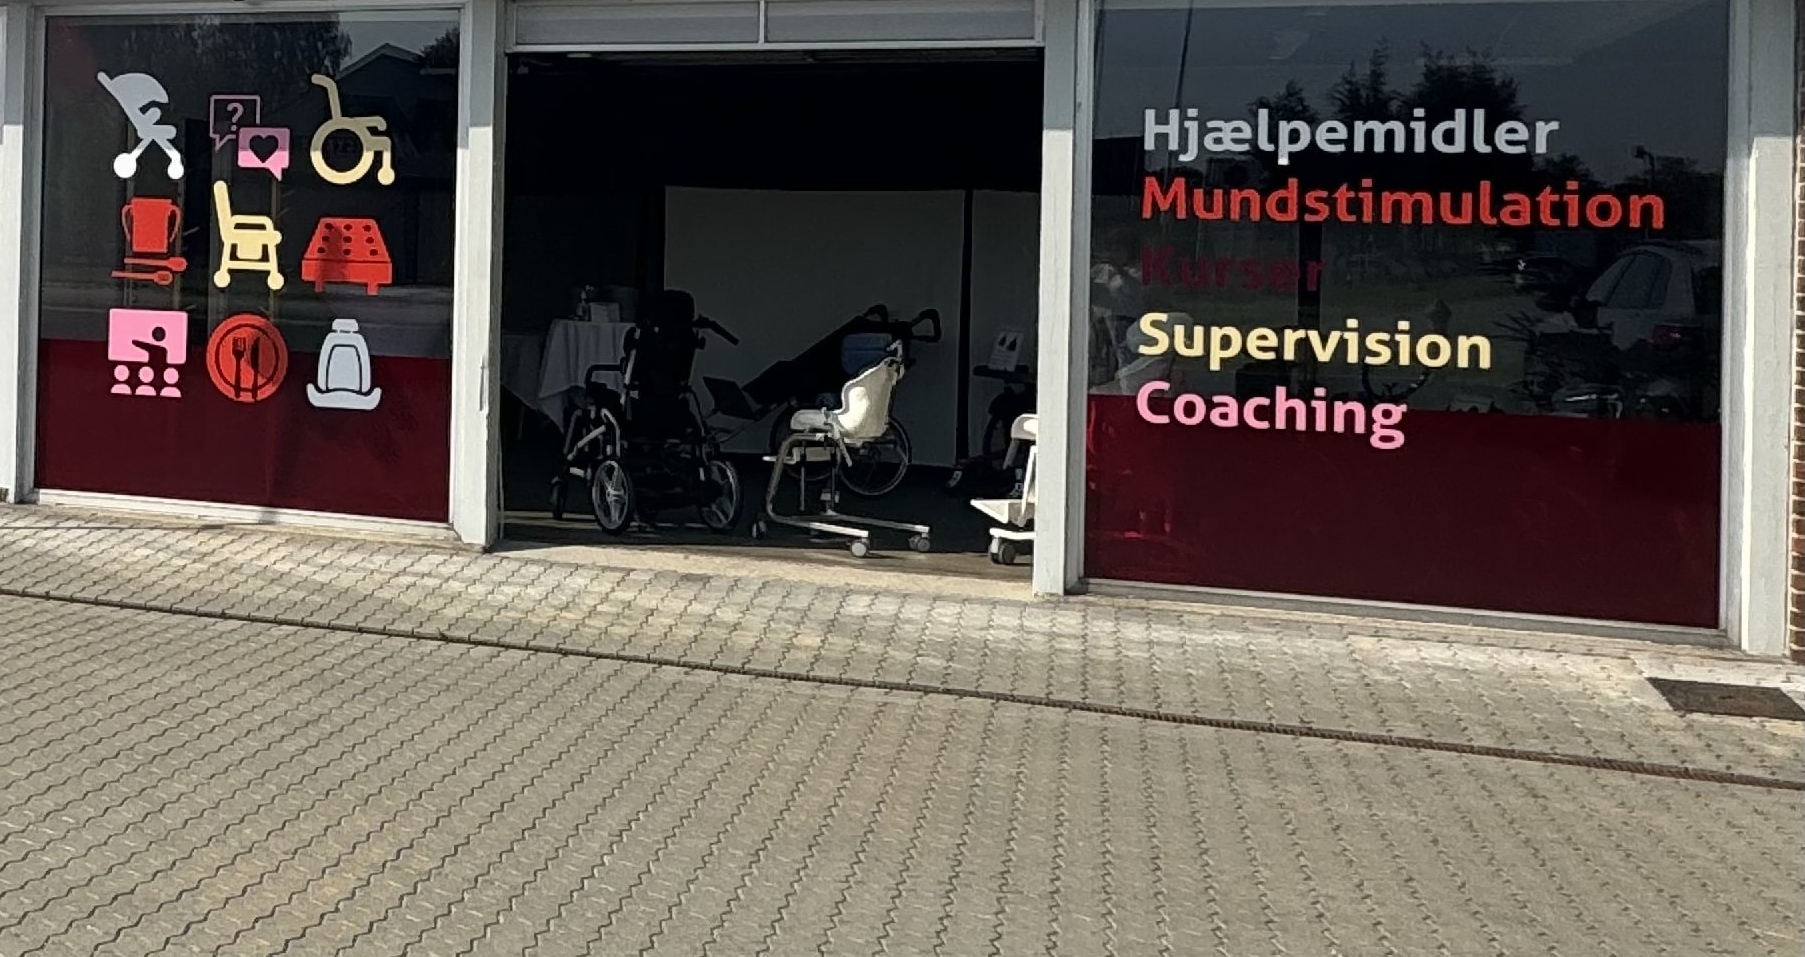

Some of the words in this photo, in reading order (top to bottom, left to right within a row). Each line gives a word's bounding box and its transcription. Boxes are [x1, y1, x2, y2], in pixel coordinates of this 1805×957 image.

[1143, 108, 1560, 166] Hjælpemidler
[1141, 176, 1665, 230] Mundstimulation
[1140, 243, 1328, 292] Kurser
[1137, 312, 1491, 371] Supervision
[1136, 380, 1408, 450] Coaching
